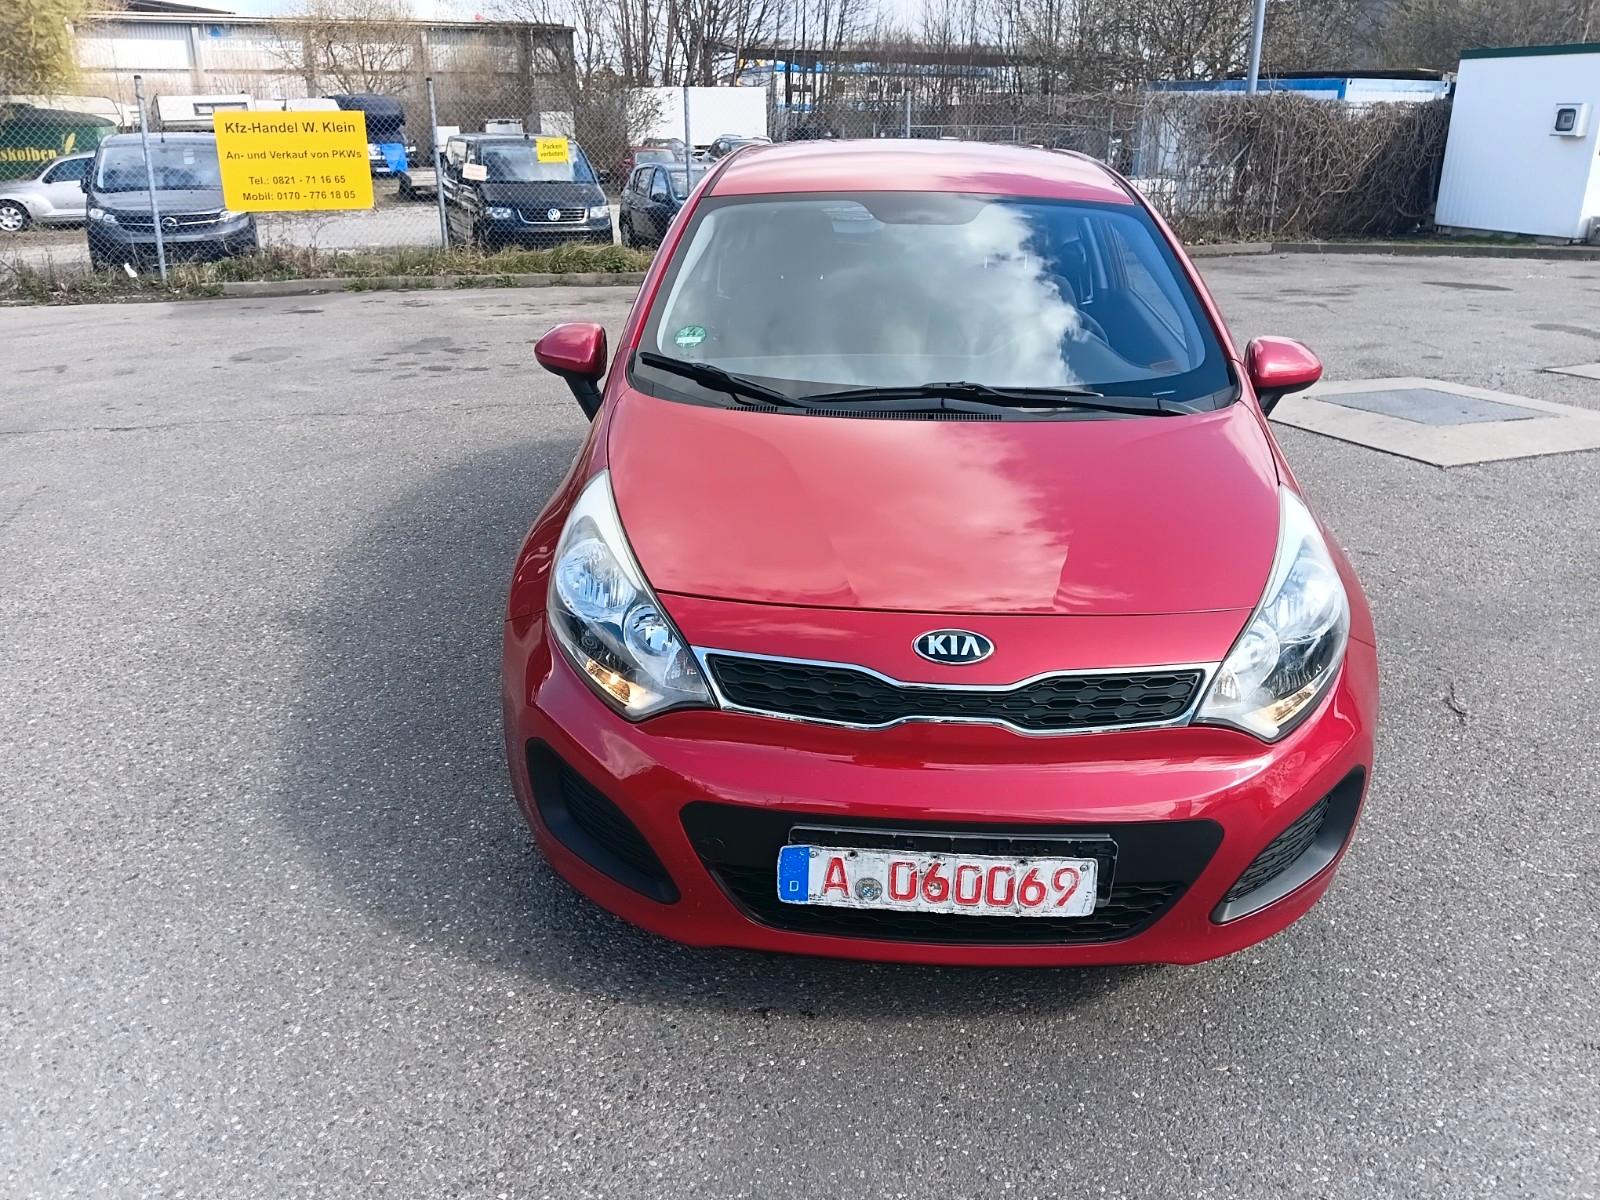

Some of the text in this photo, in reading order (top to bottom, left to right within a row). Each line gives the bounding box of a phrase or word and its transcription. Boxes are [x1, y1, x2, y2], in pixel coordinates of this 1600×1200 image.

[225, 121, 356, 133] Kfz-Handel W. Klein
[226, 149, 362, 160] An- und Verkauf von PKWs
[249, 176, 270, 185] Tel.:
[272, 176, 296, 185] 0821
[305, 176, 316, 184] 71
[320, 176, 332, 184] 16
[334, 175, 346, 184] 65
[242, 192, 274, 201] Mobil:
[276, 191, 301, 200] 0170
[309, 191, 327, 200] 776
[330, 191, 341, 199] 18
[343, 190, 356, 199] 05
[928, 635, 981, 656] KIA
[823, 856, 1081, 908] A 060069
